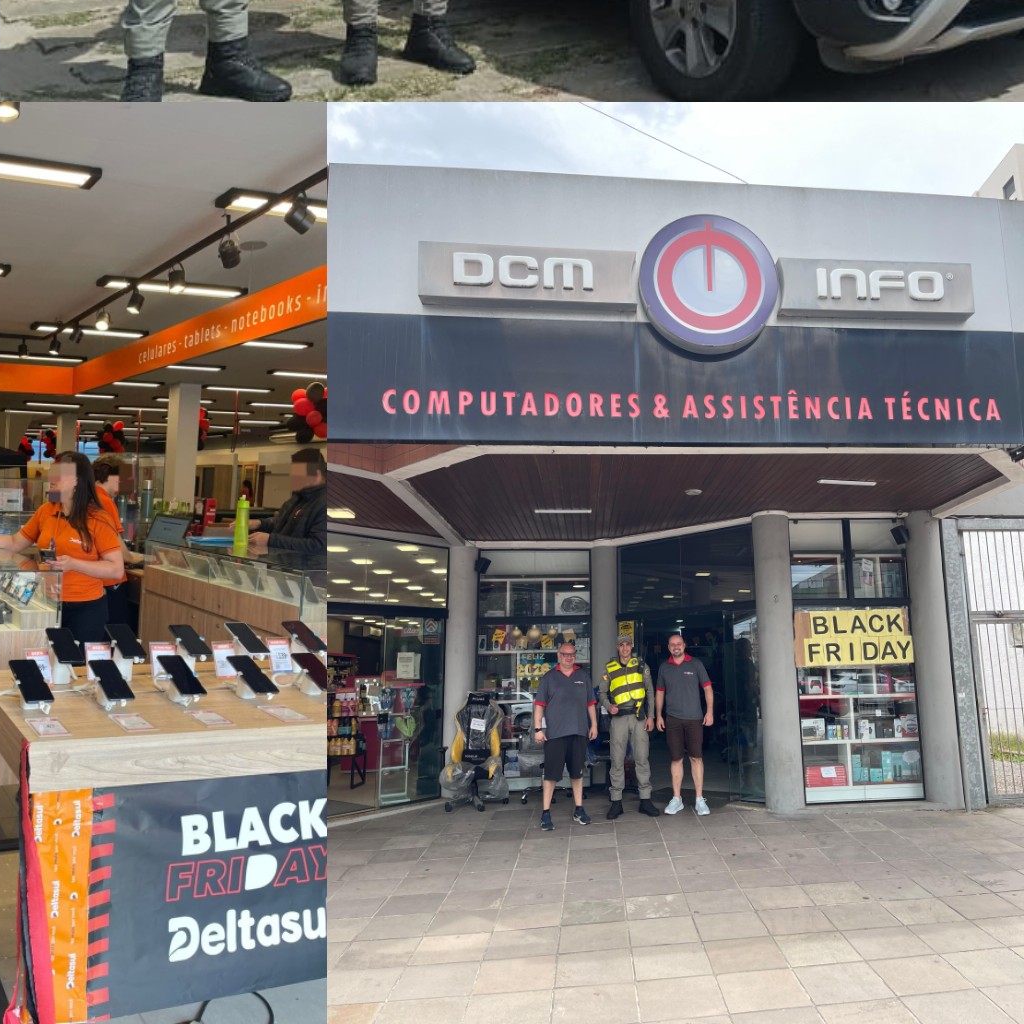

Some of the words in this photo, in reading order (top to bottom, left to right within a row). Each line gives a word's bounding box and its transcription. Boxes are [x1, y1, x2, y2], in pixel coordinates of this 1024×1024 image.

[452, 251, 594, 292] DCM
[138, 340, 177, 365] celulares
[184, 324, 222, 349] tablets
[231, 294, 302, 334] notebooks
[381, 387, 642, 419] COMPUTADORES
[653, 393, 670, 420] &
[682, 389, 874, 421] ASSISTÊNCIA
[885, 389, 1002, 422] TÉCNICA
[812, 613, 903, 635] BLACK
[521, 653, 546, 661] FELIZ
[807, 640, 911, 663] FRIDAY
[34, 804, 44, 843] Deltasul
[72, 800, 82, 838] Deltasul
[181, 798, 327, 857] BLACK
[165, 844, 327, 903] FRIDAY
[51, 880, 61, 919] Deltasul
[168, 906, 327, 963] Deltasu
[66, 953, 76, 990] Deltasul
